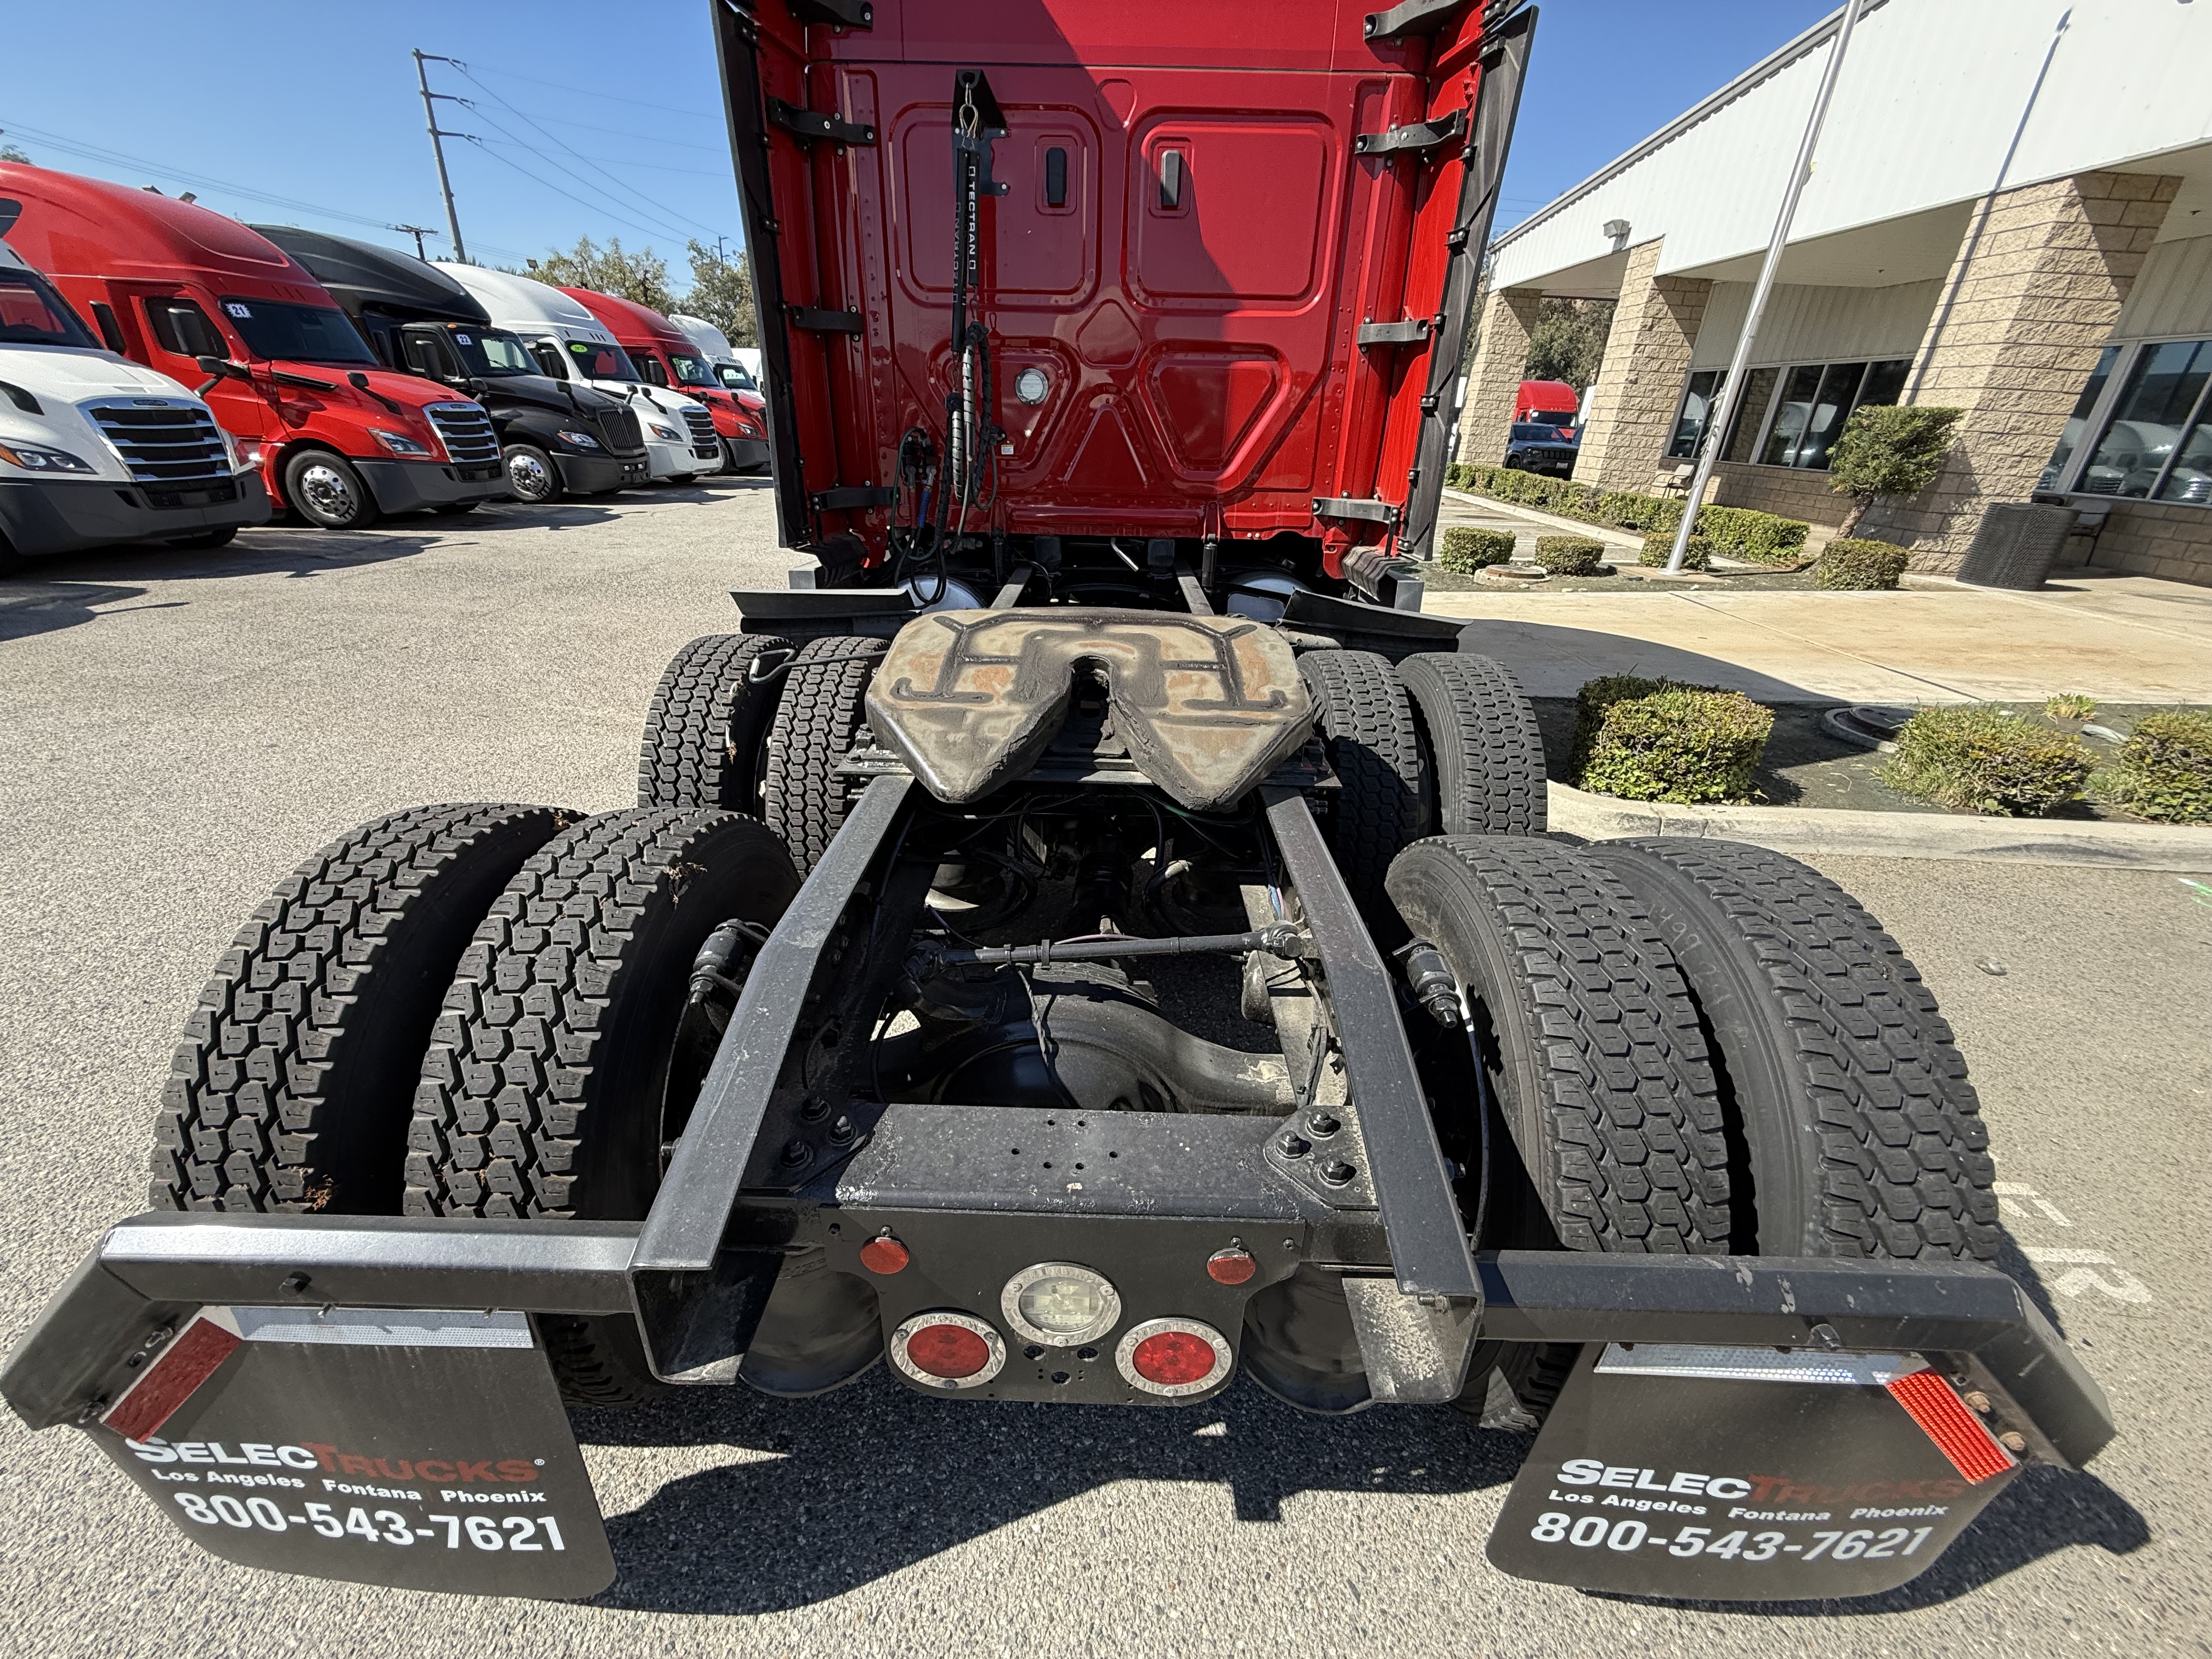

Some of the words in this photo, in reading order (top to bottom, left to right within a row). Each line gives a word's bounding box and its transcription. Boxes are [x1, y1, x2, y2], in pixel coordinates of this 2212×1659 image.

[232, 306, 246, 315] 21
[151, 1468, 200, 1482] Los
[207, 1471, 306, 1487] Angeles
[321, 1479, 422, 1501] Fontana
[440, 1489, 548, 1503] Phoenix
[173, 1492, 566, 1551] 800-543-7621
[1548, 1489, 1595, 1503] Los
[1600, 1494, 1708, 1515] Angeles
[1728, 1507, 1832, 1521] Fontana
[1849, 1504, 1950, 1519] Phoenix
[1531, 1512, 1934, 1561] 800-543-7621
